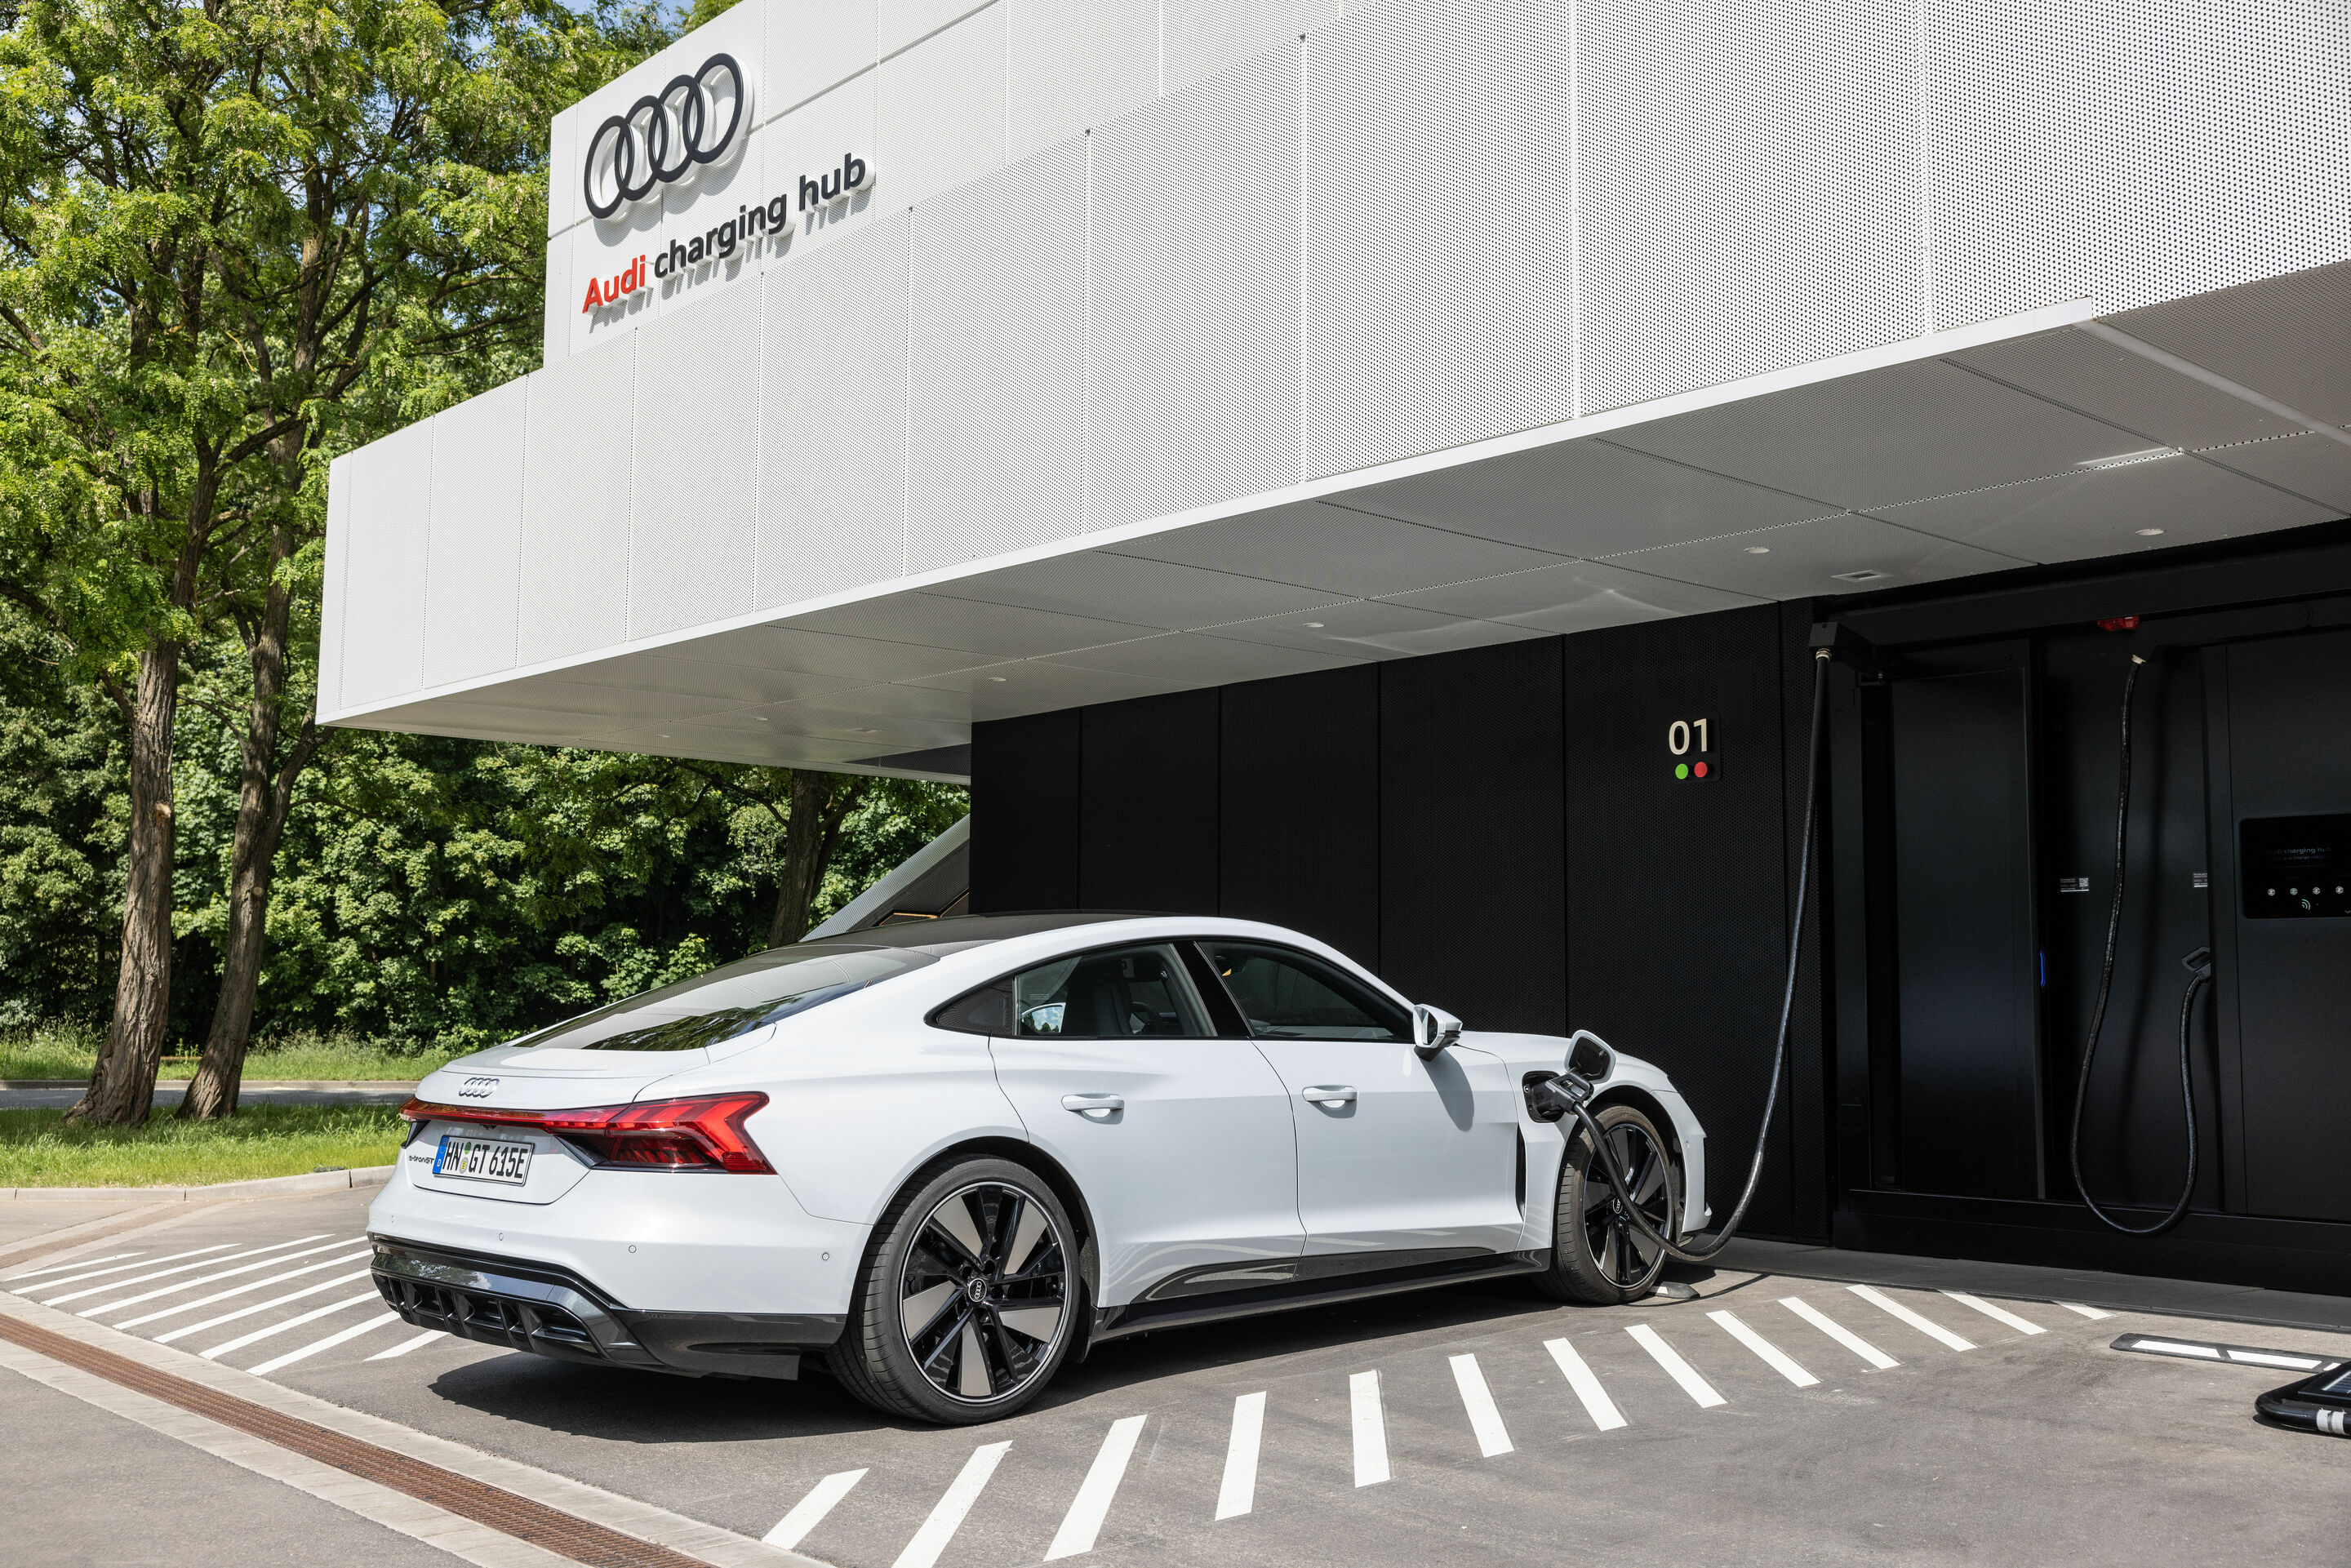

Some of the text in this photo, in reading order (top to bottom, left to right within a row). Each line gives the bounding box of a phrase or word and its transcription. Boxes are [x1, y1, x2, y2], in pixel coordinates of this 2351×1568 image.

[581, 152, 866, 314] Audi charging hub
[1669, 717, 1708, 755] 01
[442, 1141, 529, 1179] HN GT 615E
